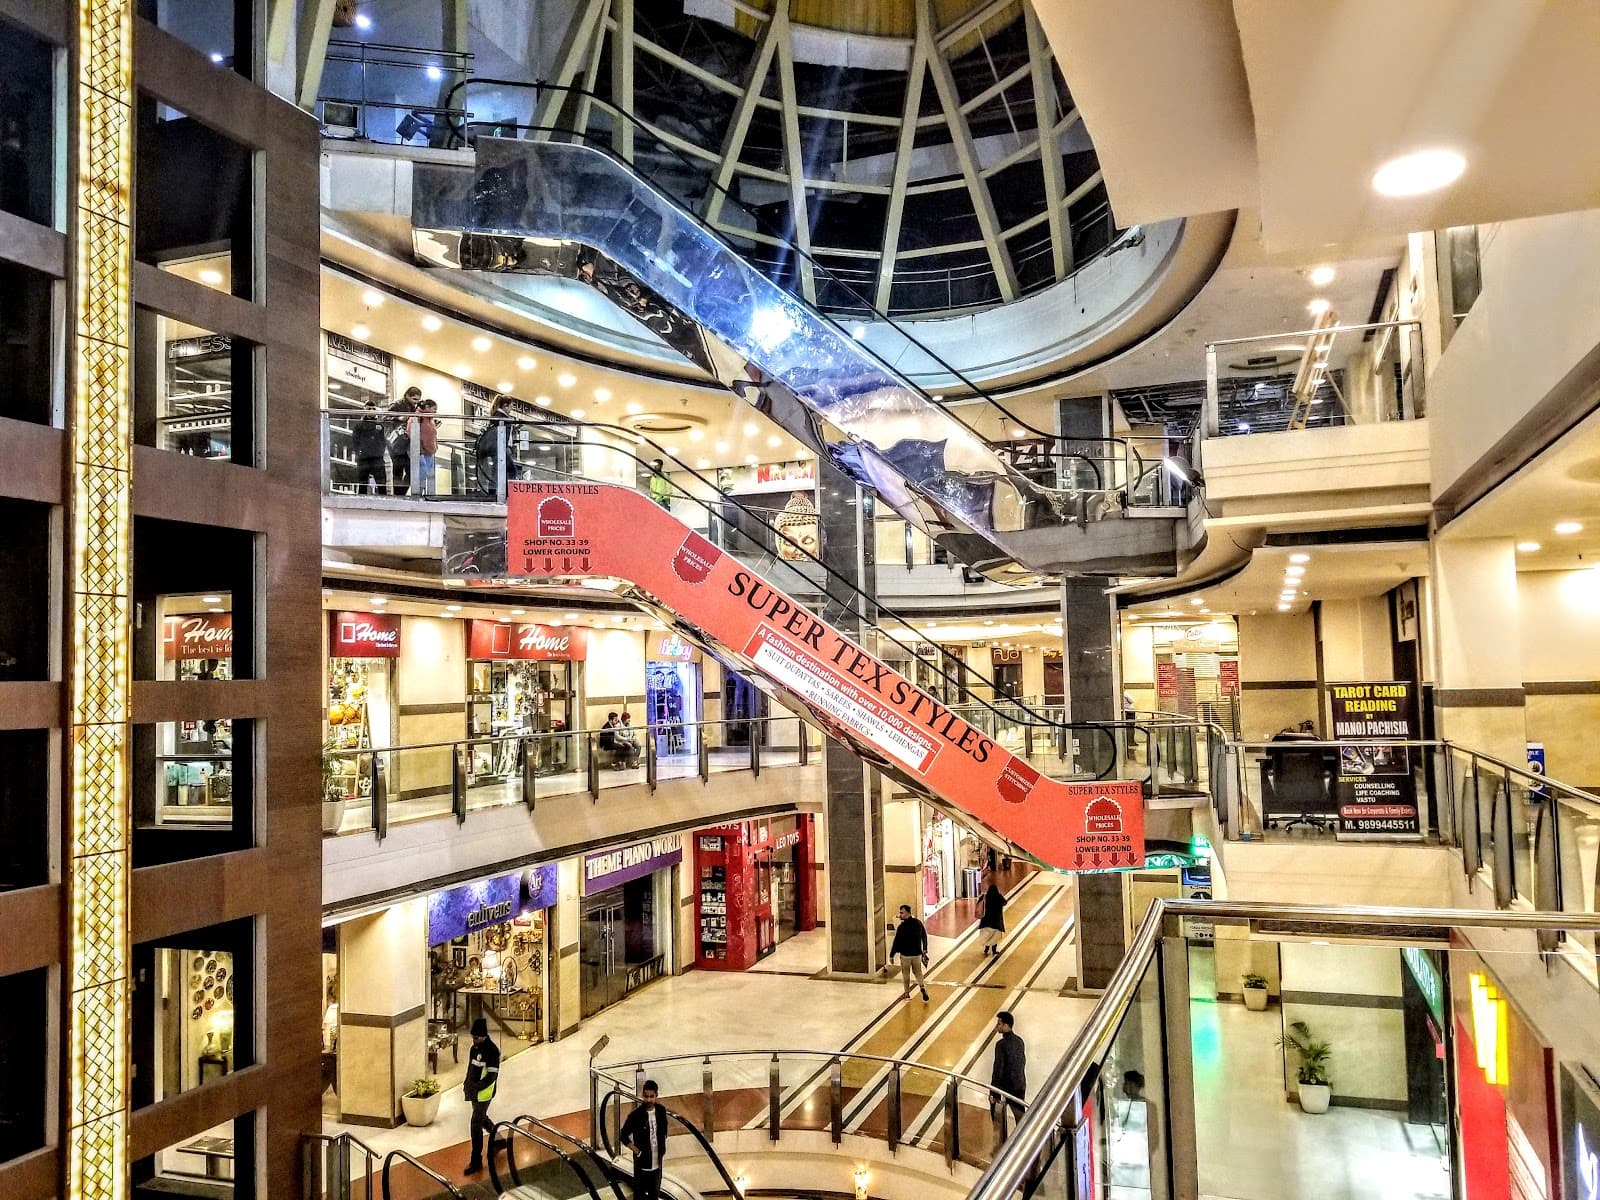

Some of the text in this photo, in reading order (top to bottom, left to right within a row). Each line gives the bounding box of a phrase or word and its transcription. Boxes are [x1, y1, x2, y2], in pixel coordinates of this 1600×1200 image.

[513, 483, 600, 495] SUPER TEX STYLES
[523, 548, 553, 556] LOWER
[681, 546, 714, 570] WHOLESALE
[683, 556, 703, 572] PRICES
[181, 617, 232, 643] Hom
[356, 622, 397, 641] Home
[518, 623, 569, 651] Home
[728, 572, 993, 762] SUPER TEX STYLES
[758, 628, 937, 754] A fashion destination with over 10,000 designs...
[1333, 685, 1407, 699] TAROT CARD
[767, 648, 926, 759] SUIT DUPATTAS SAREES SHAWLS LEHENGAS
[1345, 700, 1397, 713] READING
[808, 690, 871, 737] RUNNING FABRICS
[1336, 720, 1409, 736] MANOJ PACHISIA
[1068, 785, 1139, 796] SUPER TEX STYLES
[1345, 820, 1415, 830] M. 9899445511
[776, 831, 800, 850] LEO TOYS
[1075, 845, 1132, 853] LOWER GROUND
[586, 834, 683, 880] THEME PIANO WORLD
